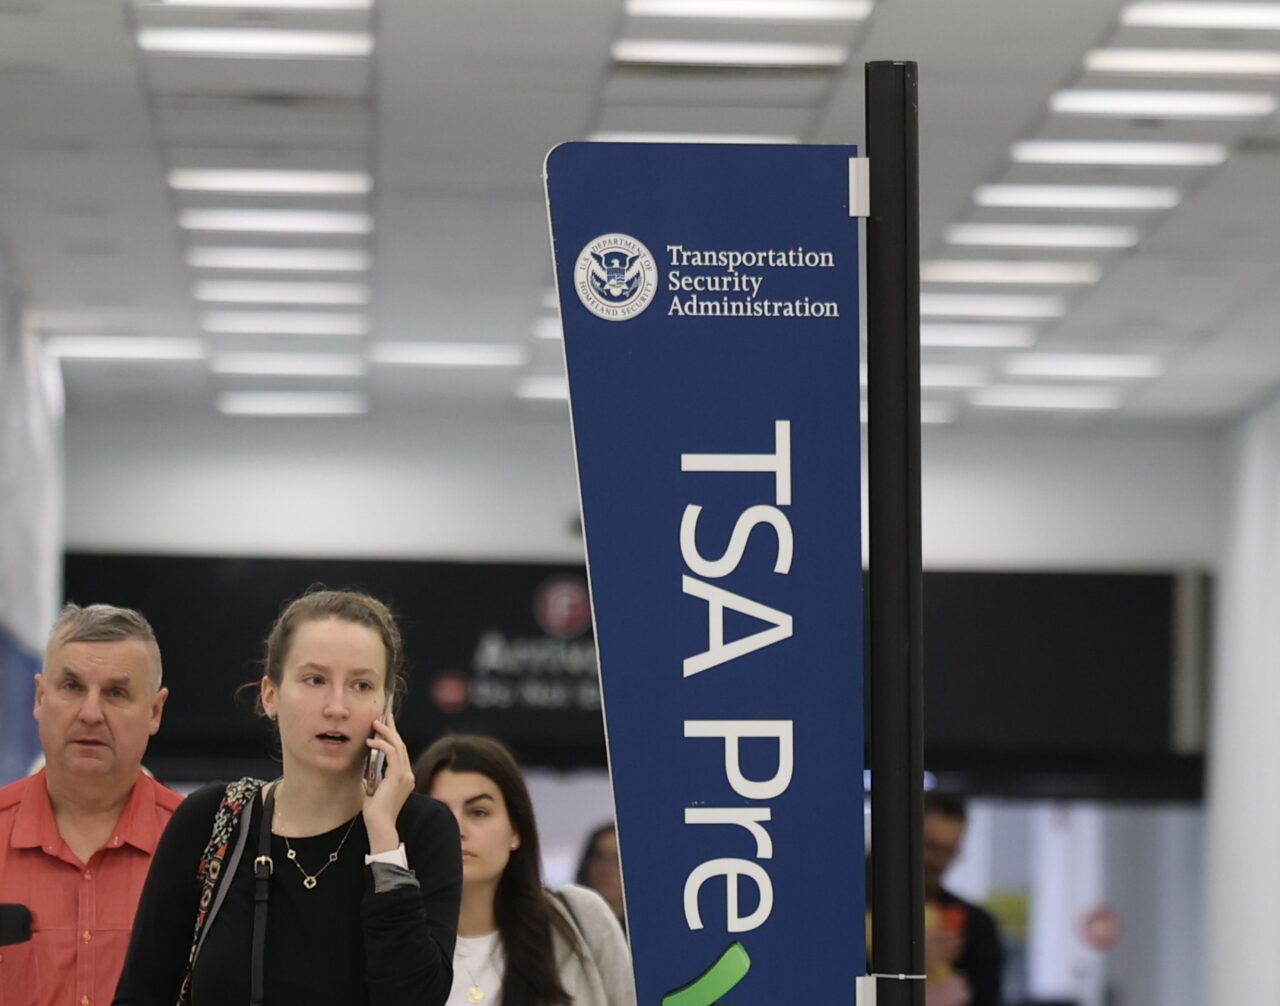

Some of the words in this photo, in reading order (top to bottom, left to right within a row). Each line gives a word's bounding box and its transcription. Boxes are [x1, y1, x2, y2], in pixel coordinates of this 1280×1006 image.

[591, 238, 648, 259] DEPARTMENT
[643, 260, 653, 272] OF
[666, 244, 835, 273] Transportation
[579, 281, 618, 316] HOMELAND
[621, 281, 653, 316] SECURITY
[668, 270, 763, 298] Security
[667, 294, 840, 318] Administration
[679, 420, 794, 678] TSA
[683, 720, 794, 933] Pre
